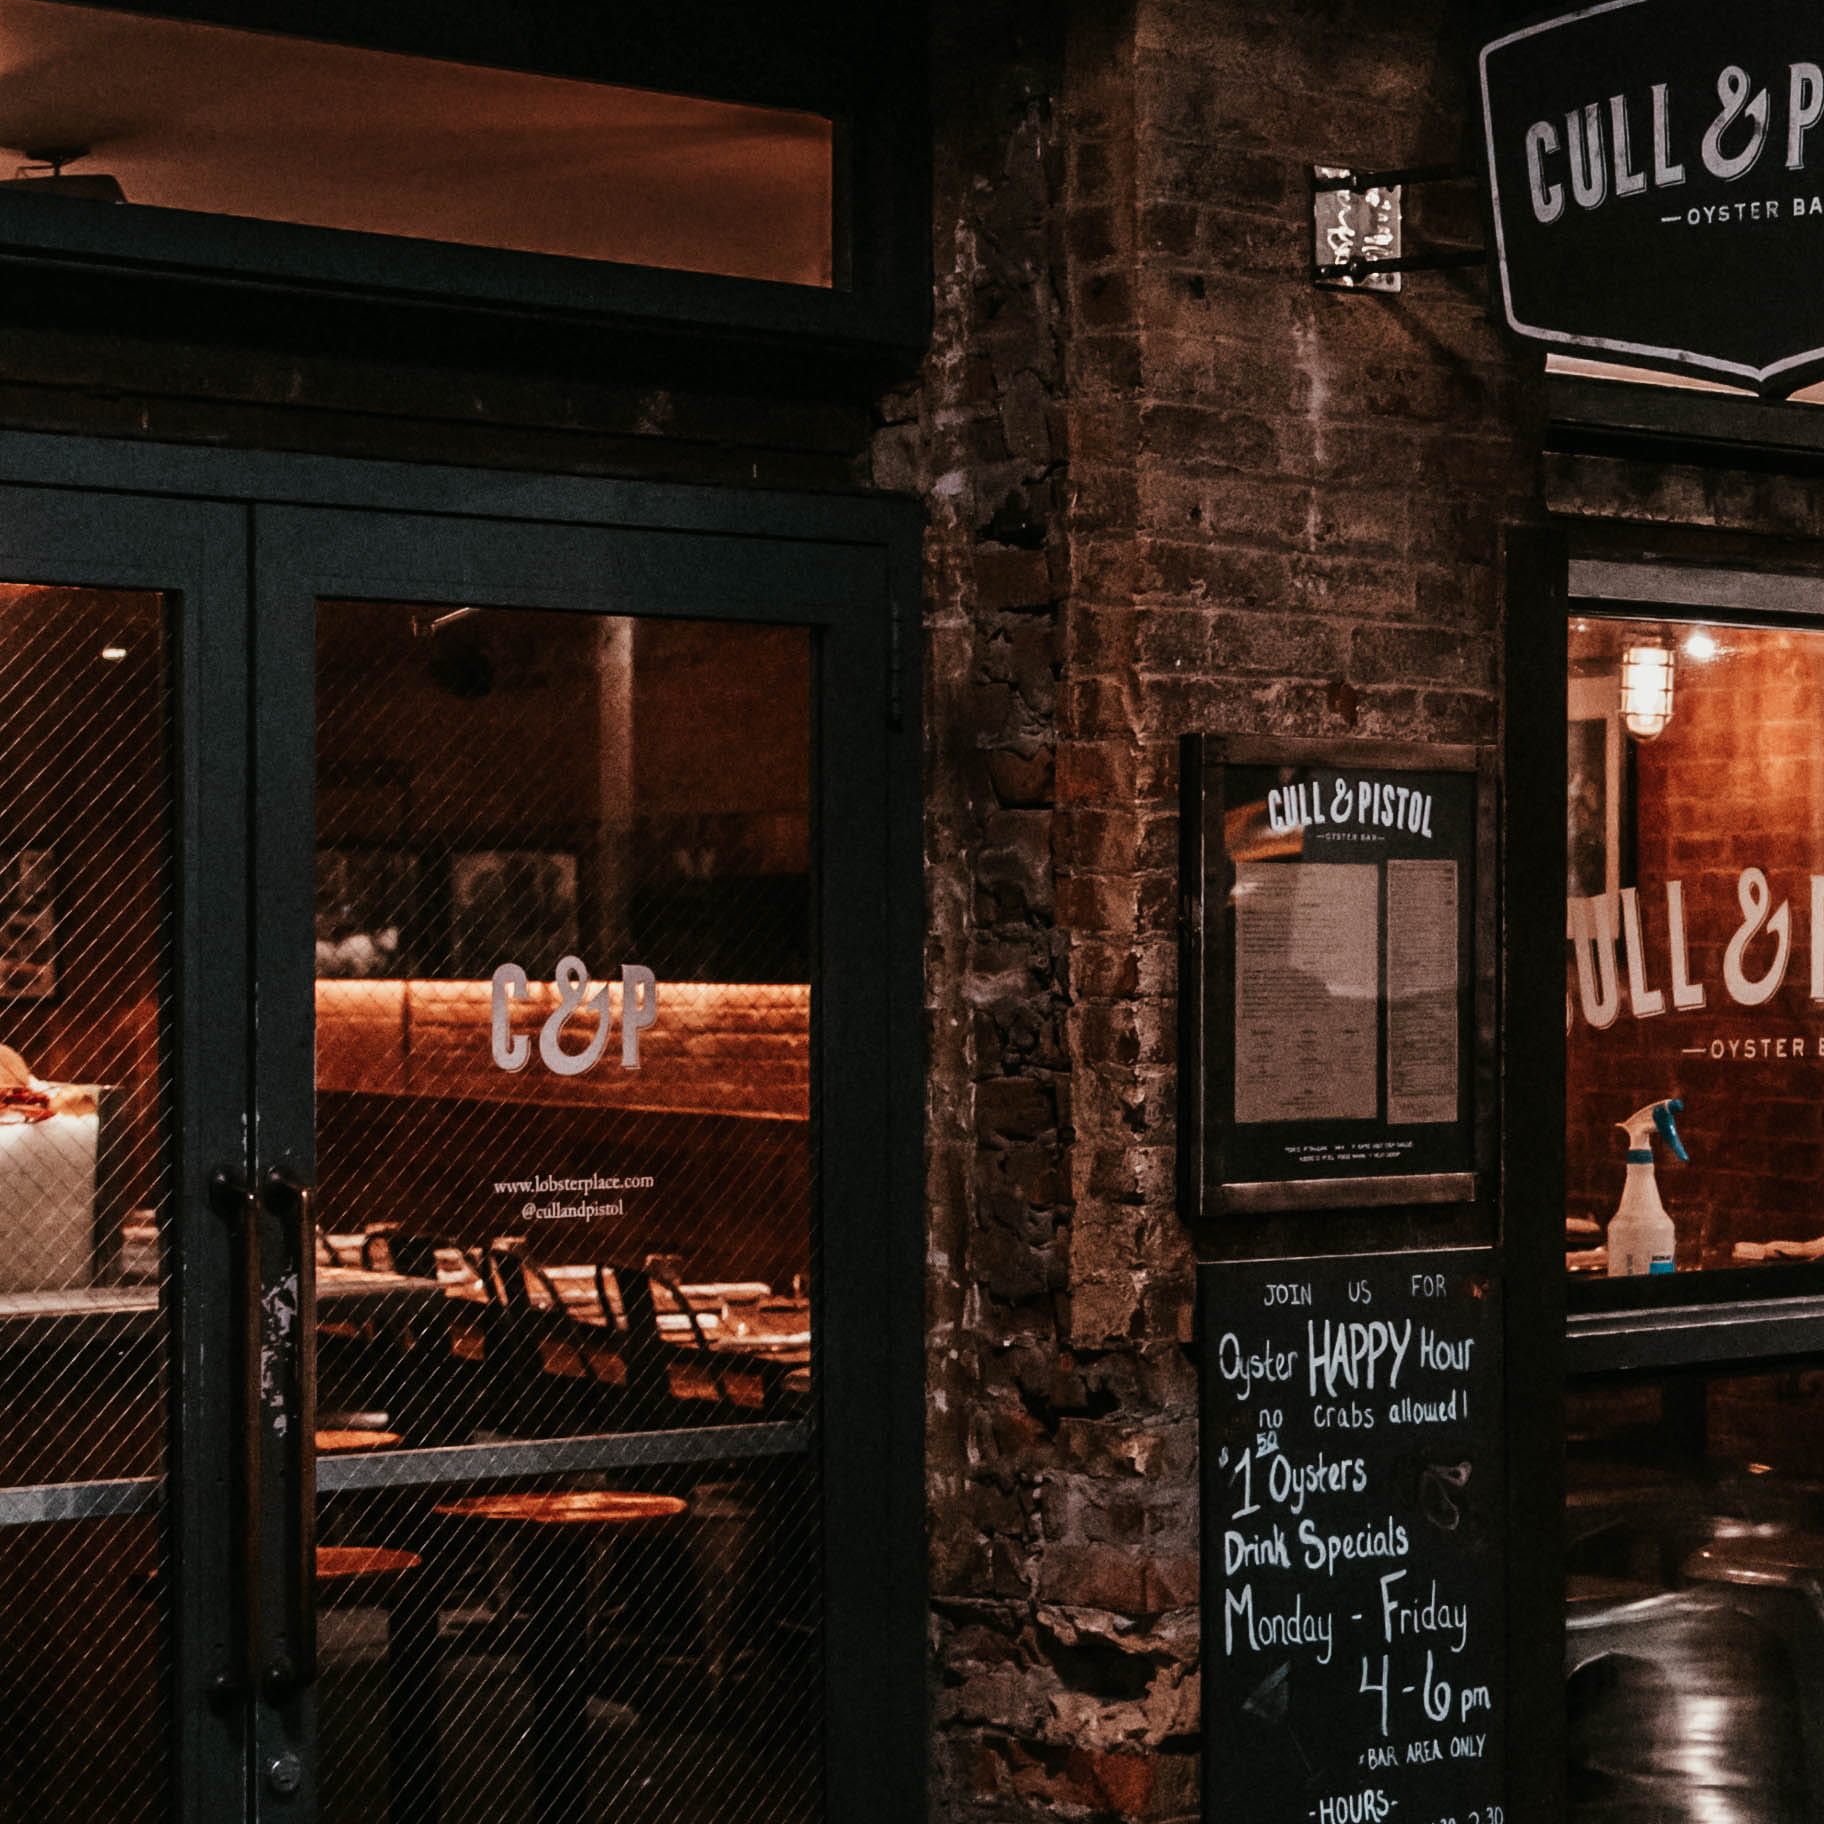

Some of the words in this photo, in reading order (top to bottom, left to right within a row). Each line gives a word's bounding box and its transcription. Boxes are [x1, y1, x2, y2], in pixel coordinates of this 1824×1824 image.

[1525, 81, 1687, 224] CULL
[1700, 64, 1771, 182] &
[1687, 199, 1779, 226] OYSTER
[1268, 780, 1326, 835] CULL
[1329, 777, 1354, 824] &
[1358, 780, 1433, 839] PISTOL
[1566, 880, 1706, 1036] ULL
[1722, 866, 1791, 1007] &
[1710, 1036, 1805, 1059] OYSTER
[493, 1171, 655, 1197] www.lobsterplace.com
[521, 1198, 625, 1223] @cullandpistol
[1263, 1282, 1312, 1307] JOIN
[1347, 1280, 1373, 1305] US
[1411, 1274, 1447, 1297] FOR
[1219, 1332, 1299, 1401] Oyster
[1307, 1318, 1412, 1398] HAPPY
[1419, 1326, 1475, 1372] Hour
[1258, 1407, 1284, 1429] no
[1269, 1451, 1368, 1515] Oysters
[1224, 1522, 1292, 1577] Drink
[1299, 1514, 1410, 1577] Specials
[1224, 1583, 1333, 1665] Monday
[1379, 1569, 1468, 1653] Friday
[1460, 1685, 1492, 1724] pm
[1405, 1739, 1443, 1764] AREA
[1449, 1733, 1487, 1758] ONLY
